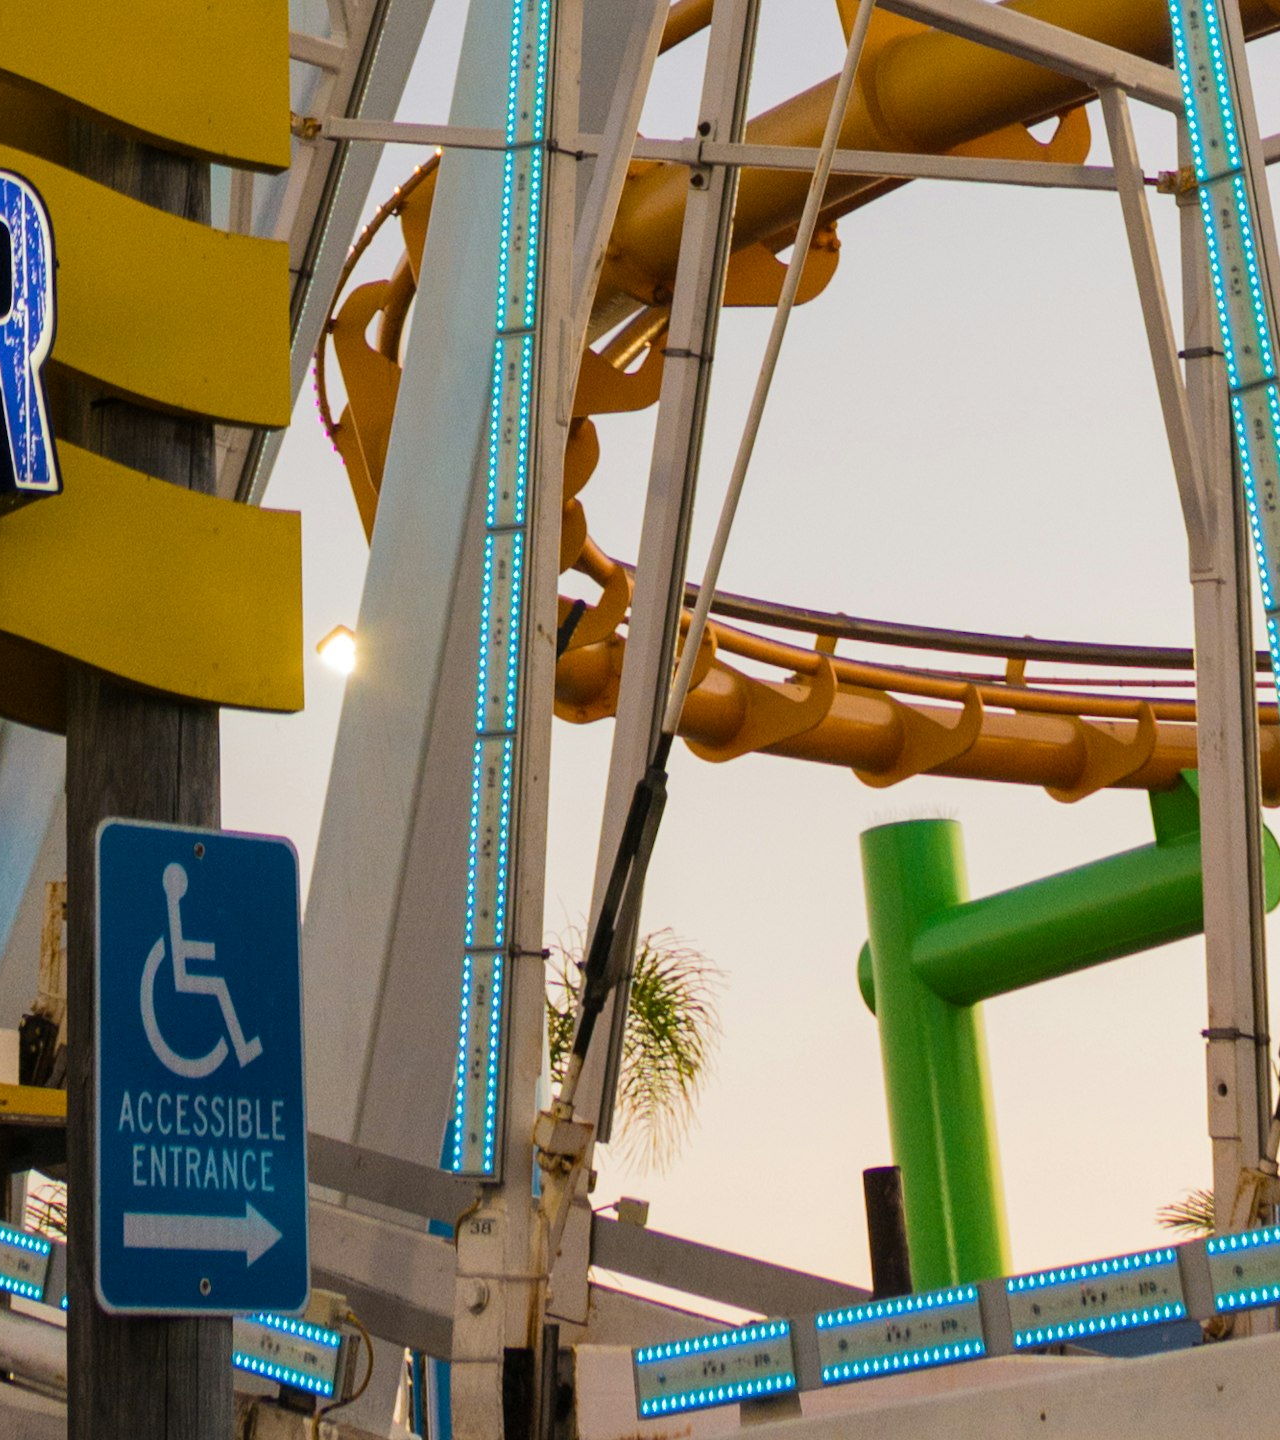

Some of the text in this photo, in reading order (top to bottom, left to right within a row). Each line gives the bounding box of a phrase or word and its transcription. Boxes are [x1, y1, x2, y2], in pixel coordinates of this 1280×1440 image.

[119, 1090, 286, 1142] ACCESSIBLE
[131, 1144, 276, 1193] ENTRANCE
[469, 1221, 492, 1236] 38
